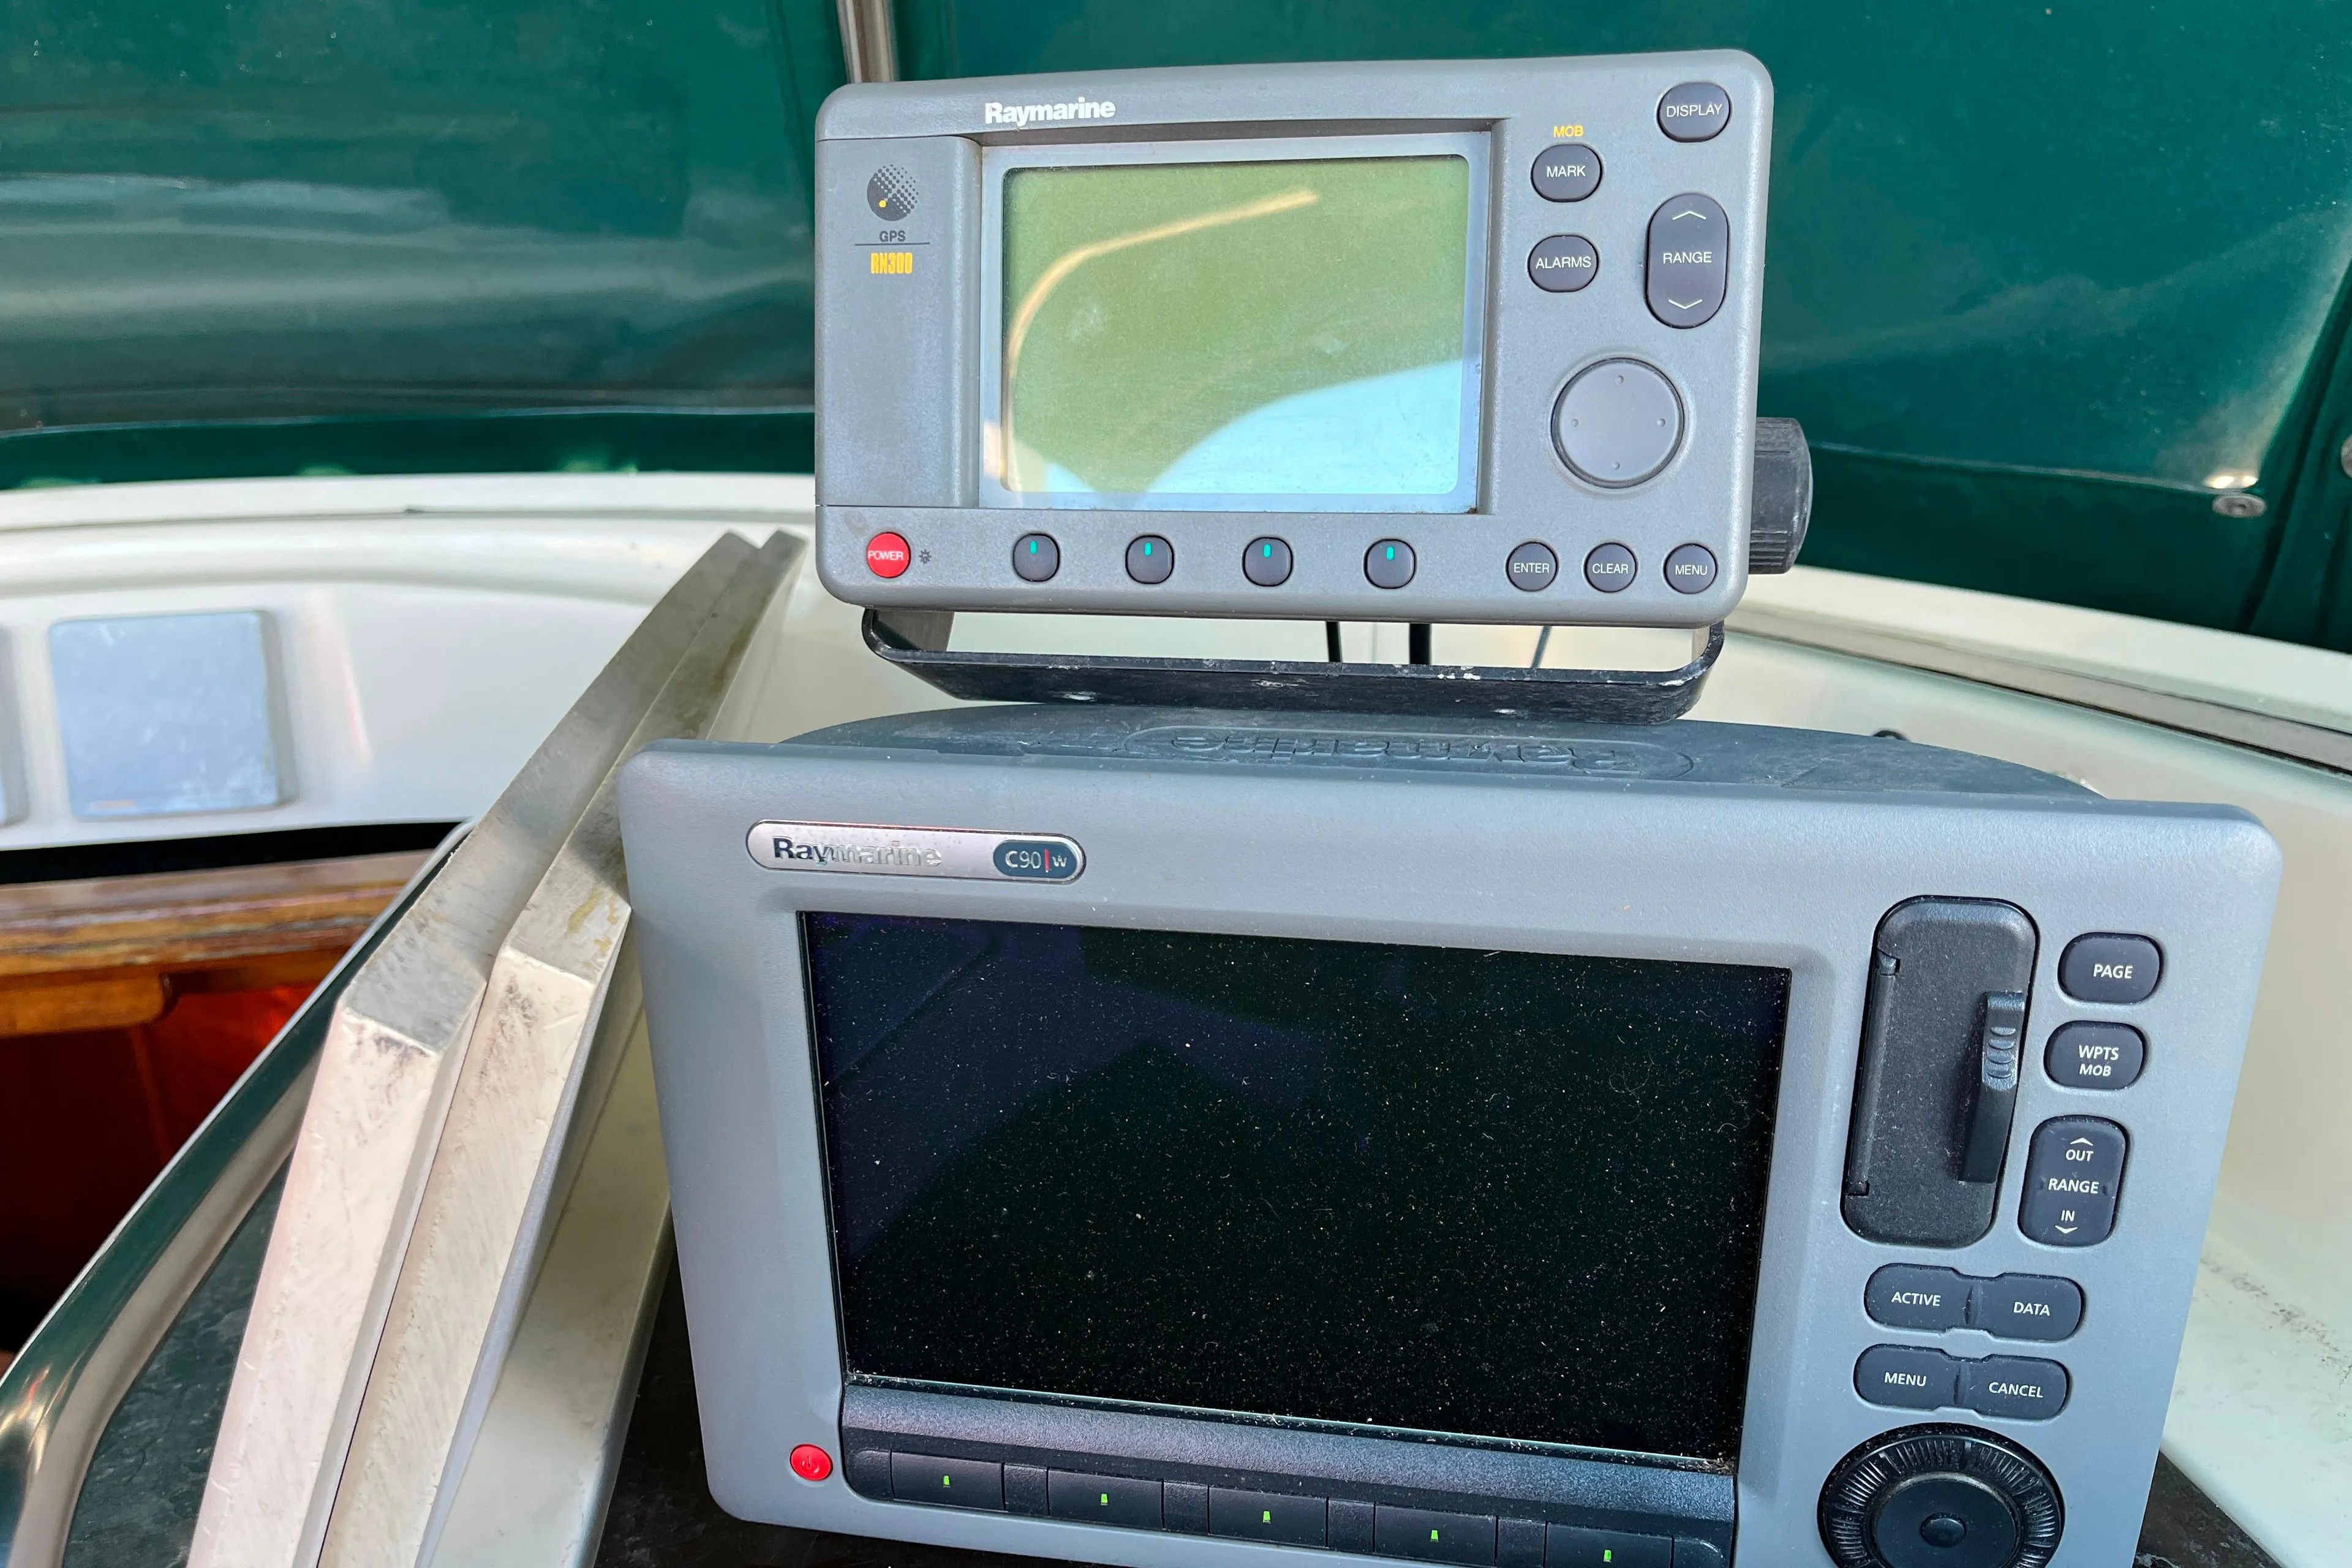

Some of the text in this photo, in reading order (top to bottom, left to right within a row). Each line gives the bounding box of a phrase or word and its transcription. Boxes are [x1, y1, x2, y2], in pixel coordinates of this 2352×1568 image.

[984, 97, 1117, 127] Raymarine
[1666, 104, 1722, 117] DISPLAY
[1553, 125, 1584, 138] MOB
[1547, 165, 1586, 178] MARK
[879, 230, 907, 243] GPS
[870, 252, 913, 274] RN300
[1536, 256, 1592, 270] ALARMS
[1662, 251, 1713, 265] RANGE
[867, 549, 904, 562] POWER
[1513, 562, 1550, 574] ENTER
[1593, 563, 1629, 575] CLEAR
[1675, 564, 1708, 576] MENU
[772, 835, 942, 867] Raymarine
[2092, 964, 2133, 979] PAGE
[2078, 1045, 2119, 1061] WPTS
[2079, 1063, 2112, 1077] MOB
[2065, 1148, 2094, 1161] OUT
[2048, 1178, 2099, 1194] RANGE
[2060, 1210, 2075, 1222] IN
[1891, 1291, 1941, 1307] ACTIVE
[2013, 1302, 2051, 1316] DATA
[1884, 1372, 1927, 1387] MENU
[1988, 1382, 2043, 1398] CANCEL
